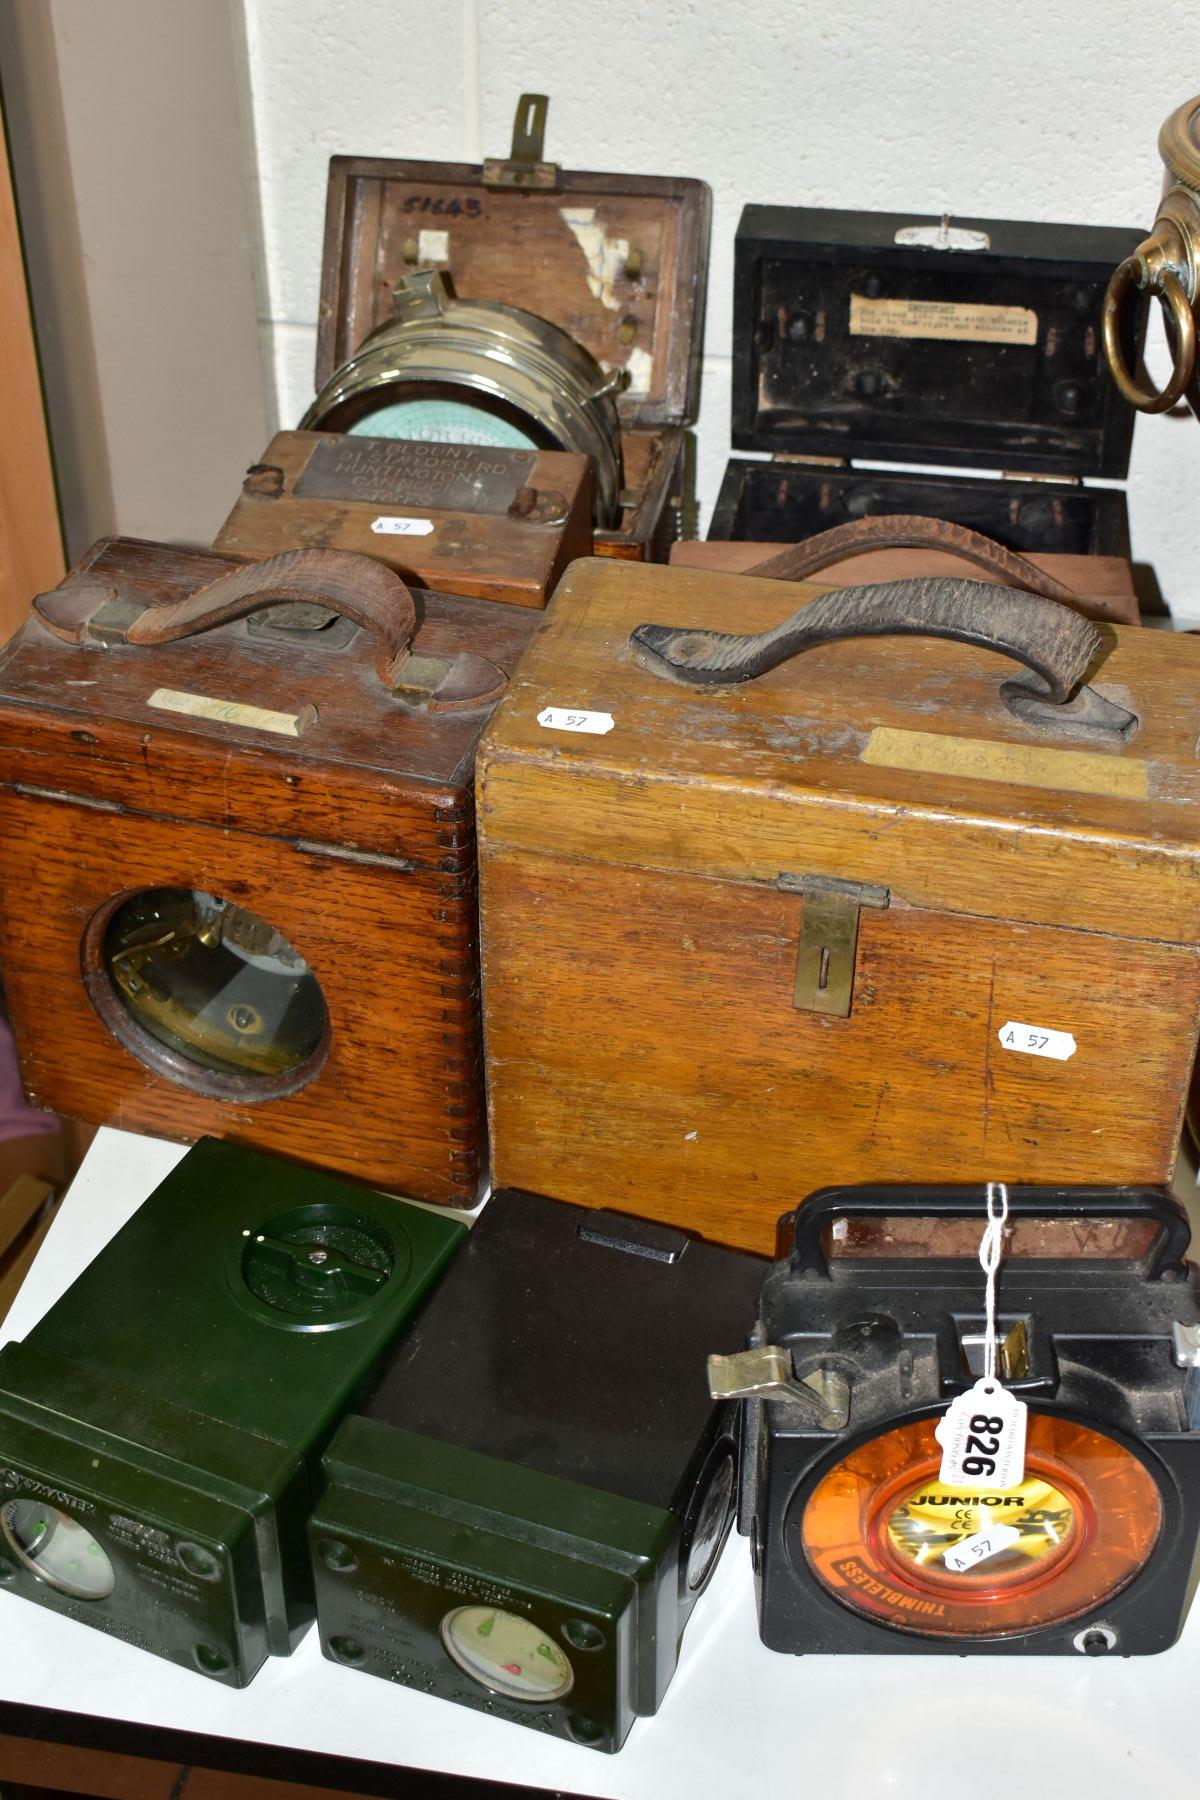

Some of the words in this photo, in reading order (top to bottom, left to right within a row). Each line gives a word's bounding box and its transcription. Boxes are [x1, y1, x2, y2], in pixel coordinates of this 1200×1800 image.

[394, 523, 411, 532] 57
[544, 714, 553, 723] A
[565, 715, 588, 727] 57
[1006, 1031, 1015, 1043] A
[1027, 1034, 1050, 1049] 57
[961, 1414, 1004, 1477] 826
[910, 1495, 1025, 1507] JUNIOR
[954, 1558, 966, 1568] A
[971, 1540, 993, 1557] 57
[840, 1561, 945, 1617] THIMBLELESS
